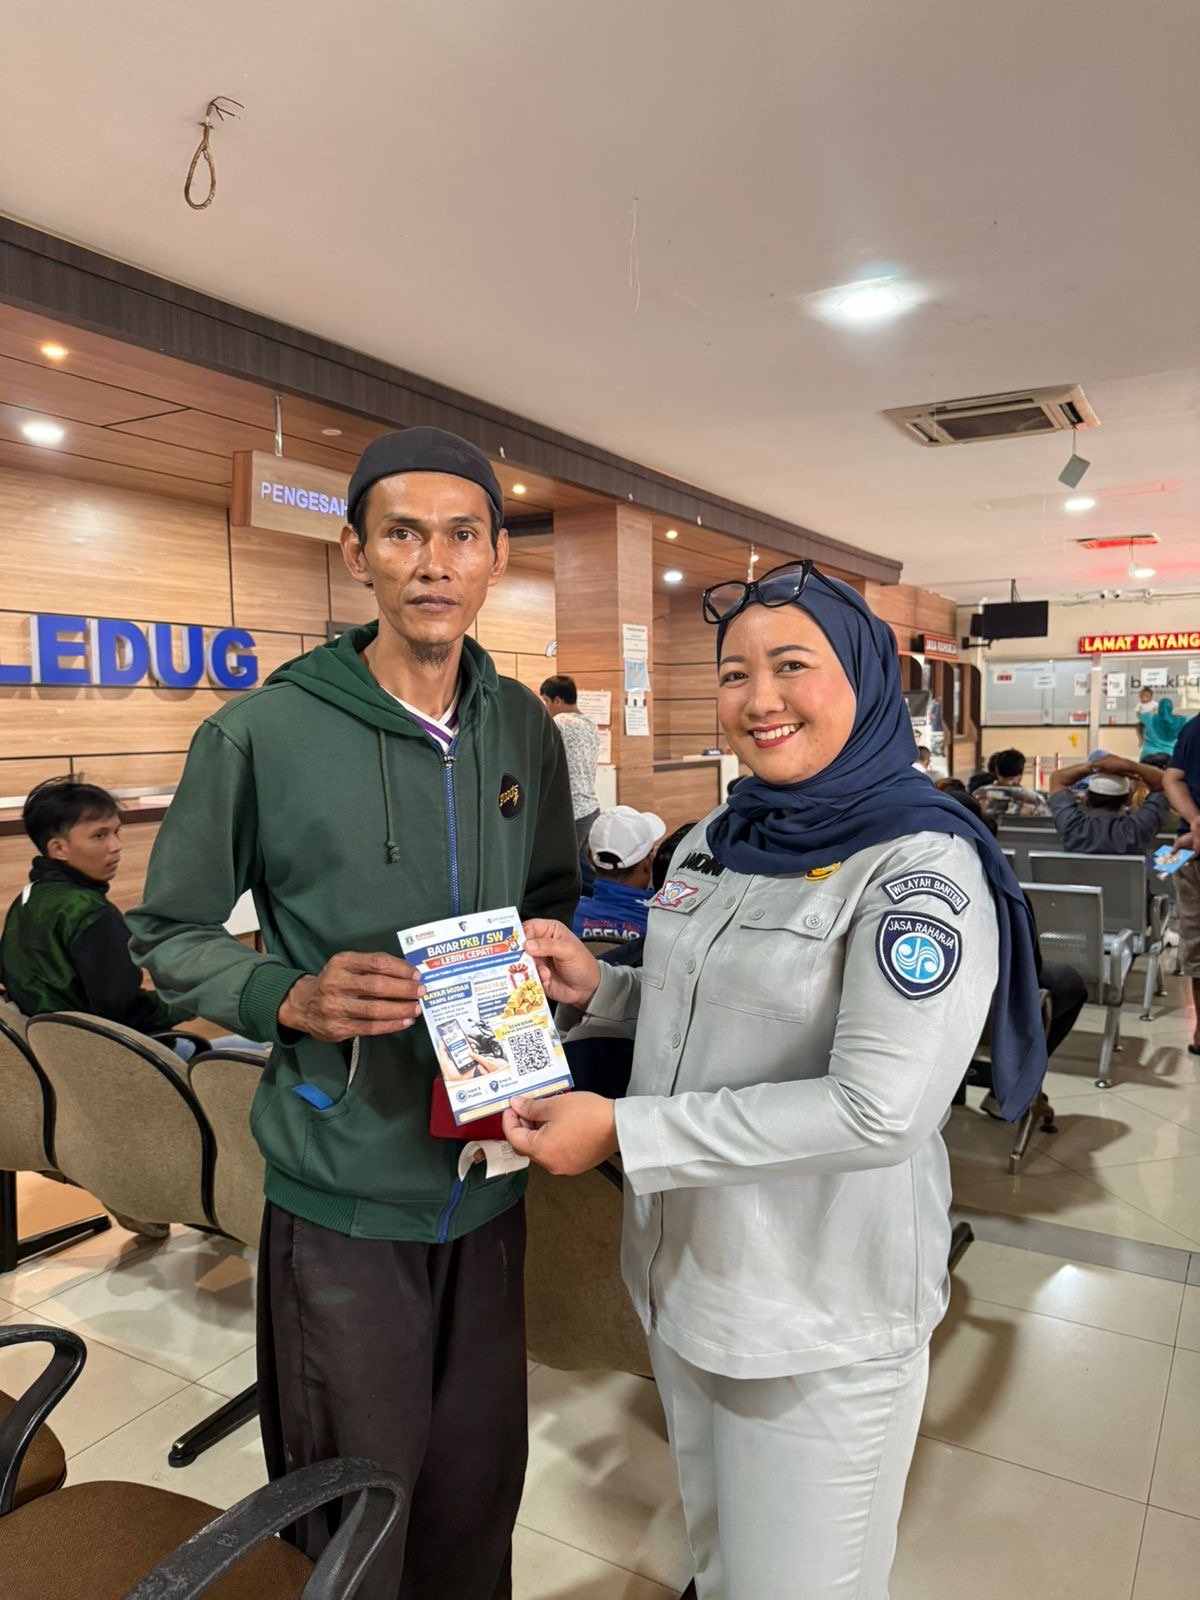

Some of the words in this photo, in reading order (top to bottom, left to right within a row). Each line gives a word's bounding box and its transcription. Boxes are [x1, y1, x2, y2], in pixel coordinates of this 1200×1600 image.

[1081, 635, 1134, 652] LAMAT
[1137, 632, 1200, 650] DATANG
[892, 878, 931, 895] WILAYAH
[933, 881, 962, 907] BANTEN
[427, 941, 460, 957] BAYAR
[460, 937, 480, 949] PKB
[486, 930, 504, 944] SW
[888, 920, 912, 931] JASA
[915, 923, 955, 949] RAHARJA
[440, 954, 465, 965] LEBIH
[466, 947, 494, 959] CEPAT!
[424, 989, 446, 1001] BAYAR
[446, 983, 470, 995] MUDAH
